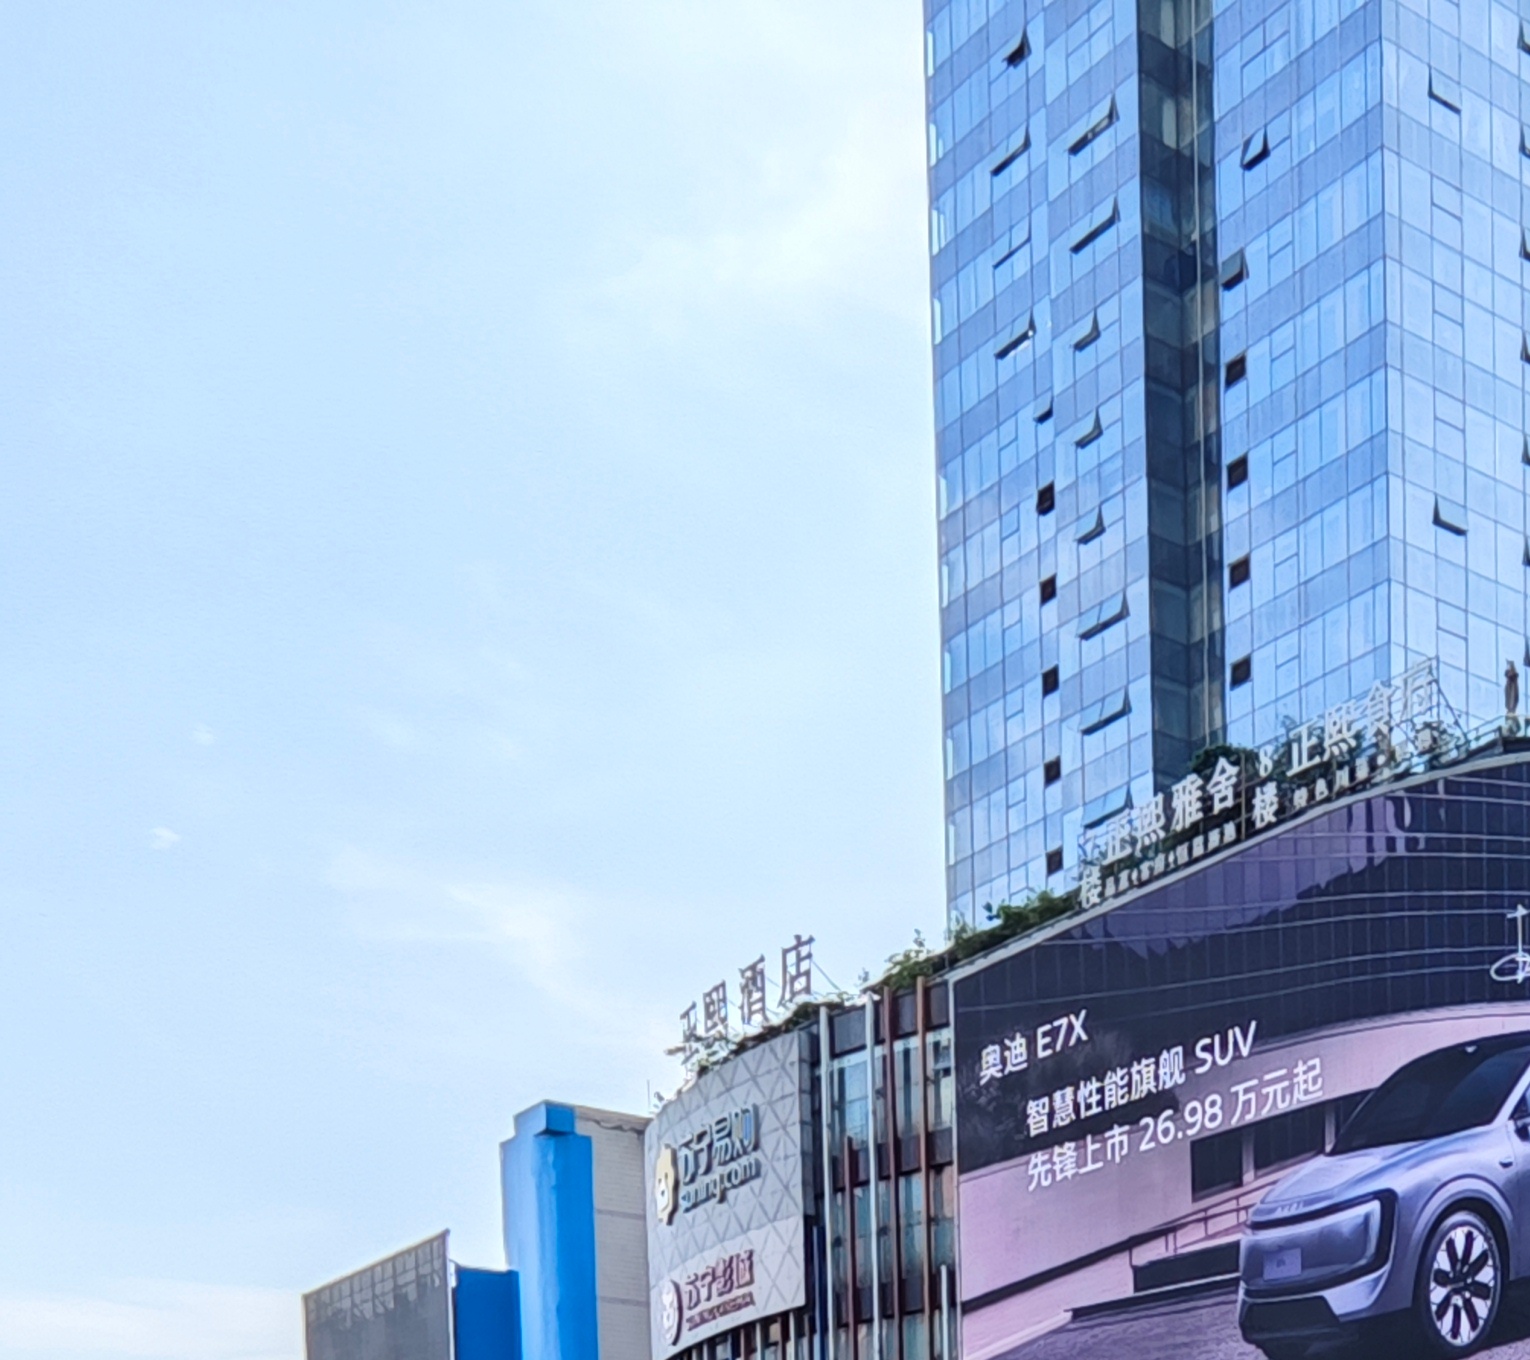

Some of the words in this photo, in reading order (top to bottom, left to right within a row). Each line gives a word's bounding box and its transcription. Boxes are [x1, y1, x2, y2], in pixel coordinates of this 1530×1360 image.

[979, 1033, 1028, 1085] 奥迪
[1036, 1009, 1089, 1060] E7X
[1026, 1045, 1186, 1138] 智慧性能旗舰
[1194, 1020, 1257, 1074] SUV
[1027, 1123, 1131, 1192] 先锋上市
[1138, 1094, 1224, 1153] 26.98
[1230, 1056, 1324, 1125] 万元起
